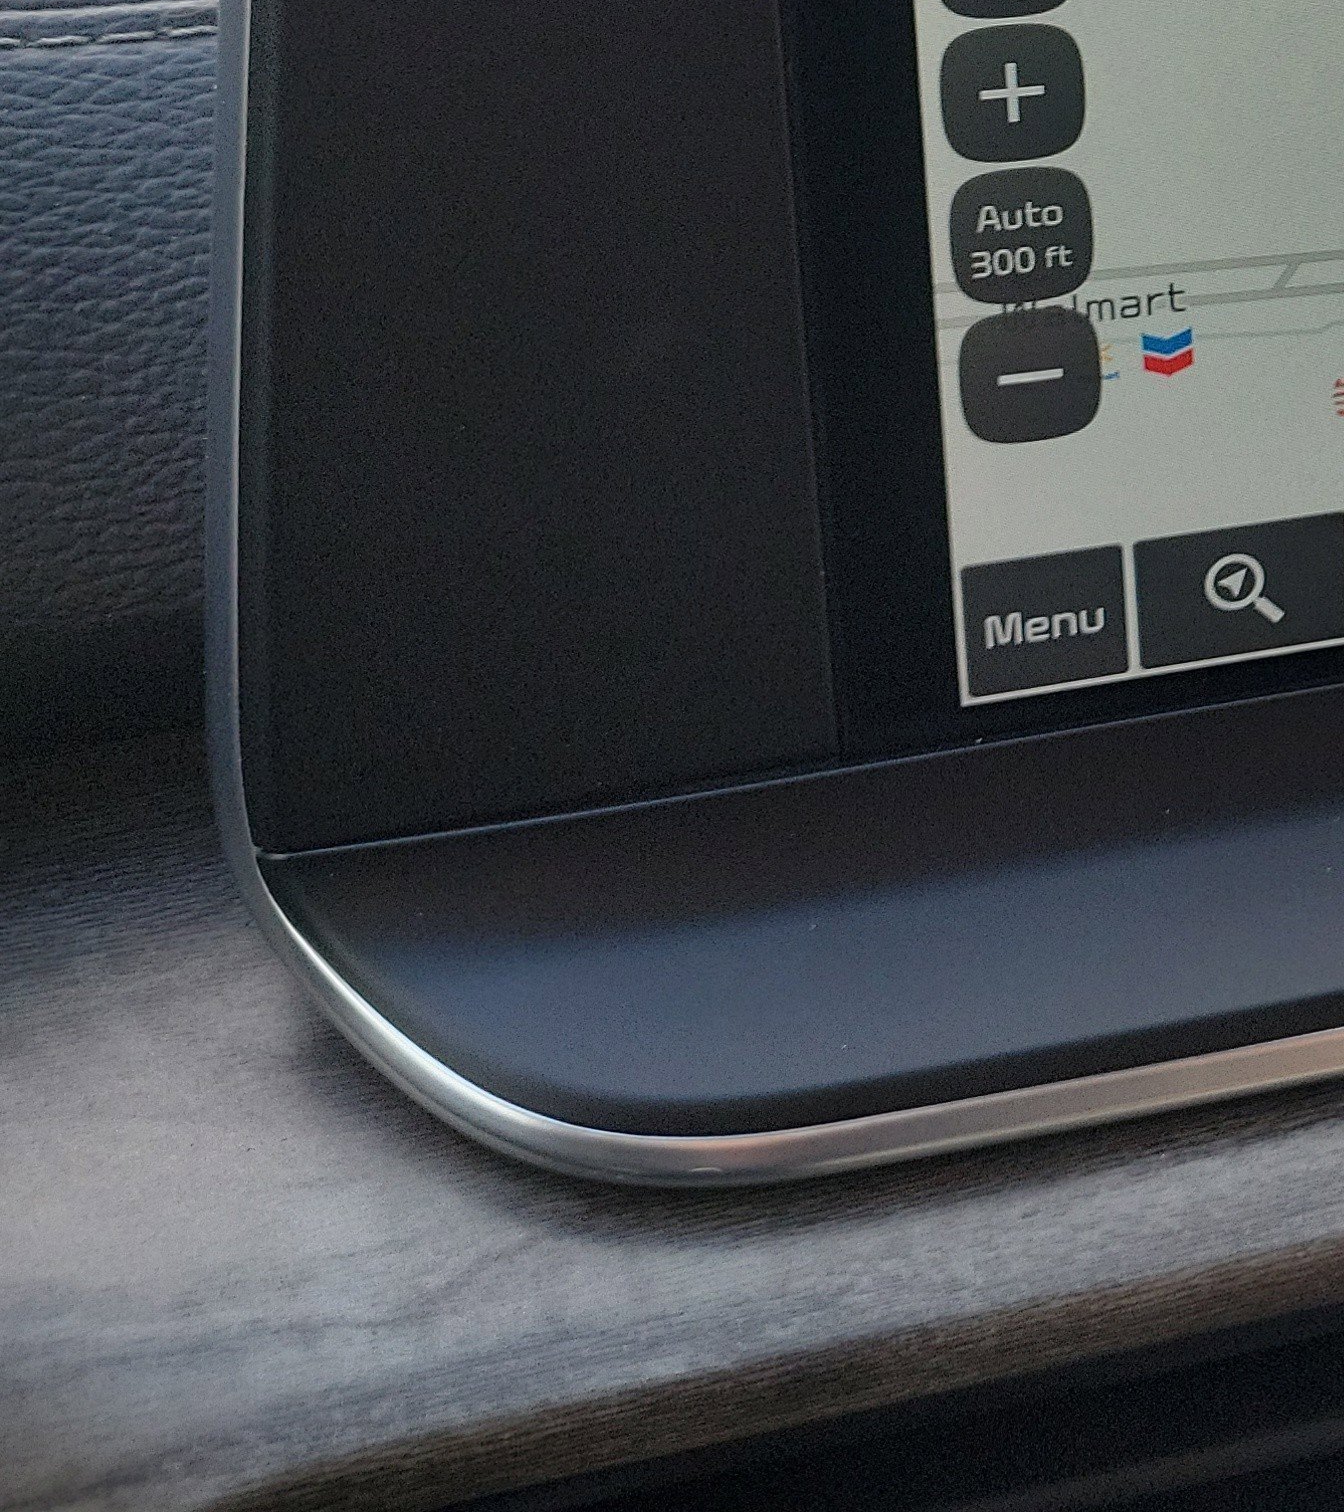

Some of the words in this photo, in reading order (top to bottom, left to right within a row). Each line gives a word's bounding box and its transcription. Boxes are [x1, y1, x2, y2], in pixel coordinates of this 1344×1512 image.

[975, 198, 1066, 233] Auto
[970, 246, 1036, 278] 300
[1046, 244, 1075, 271] ft
[985, 603, 1106, 650] Menu
